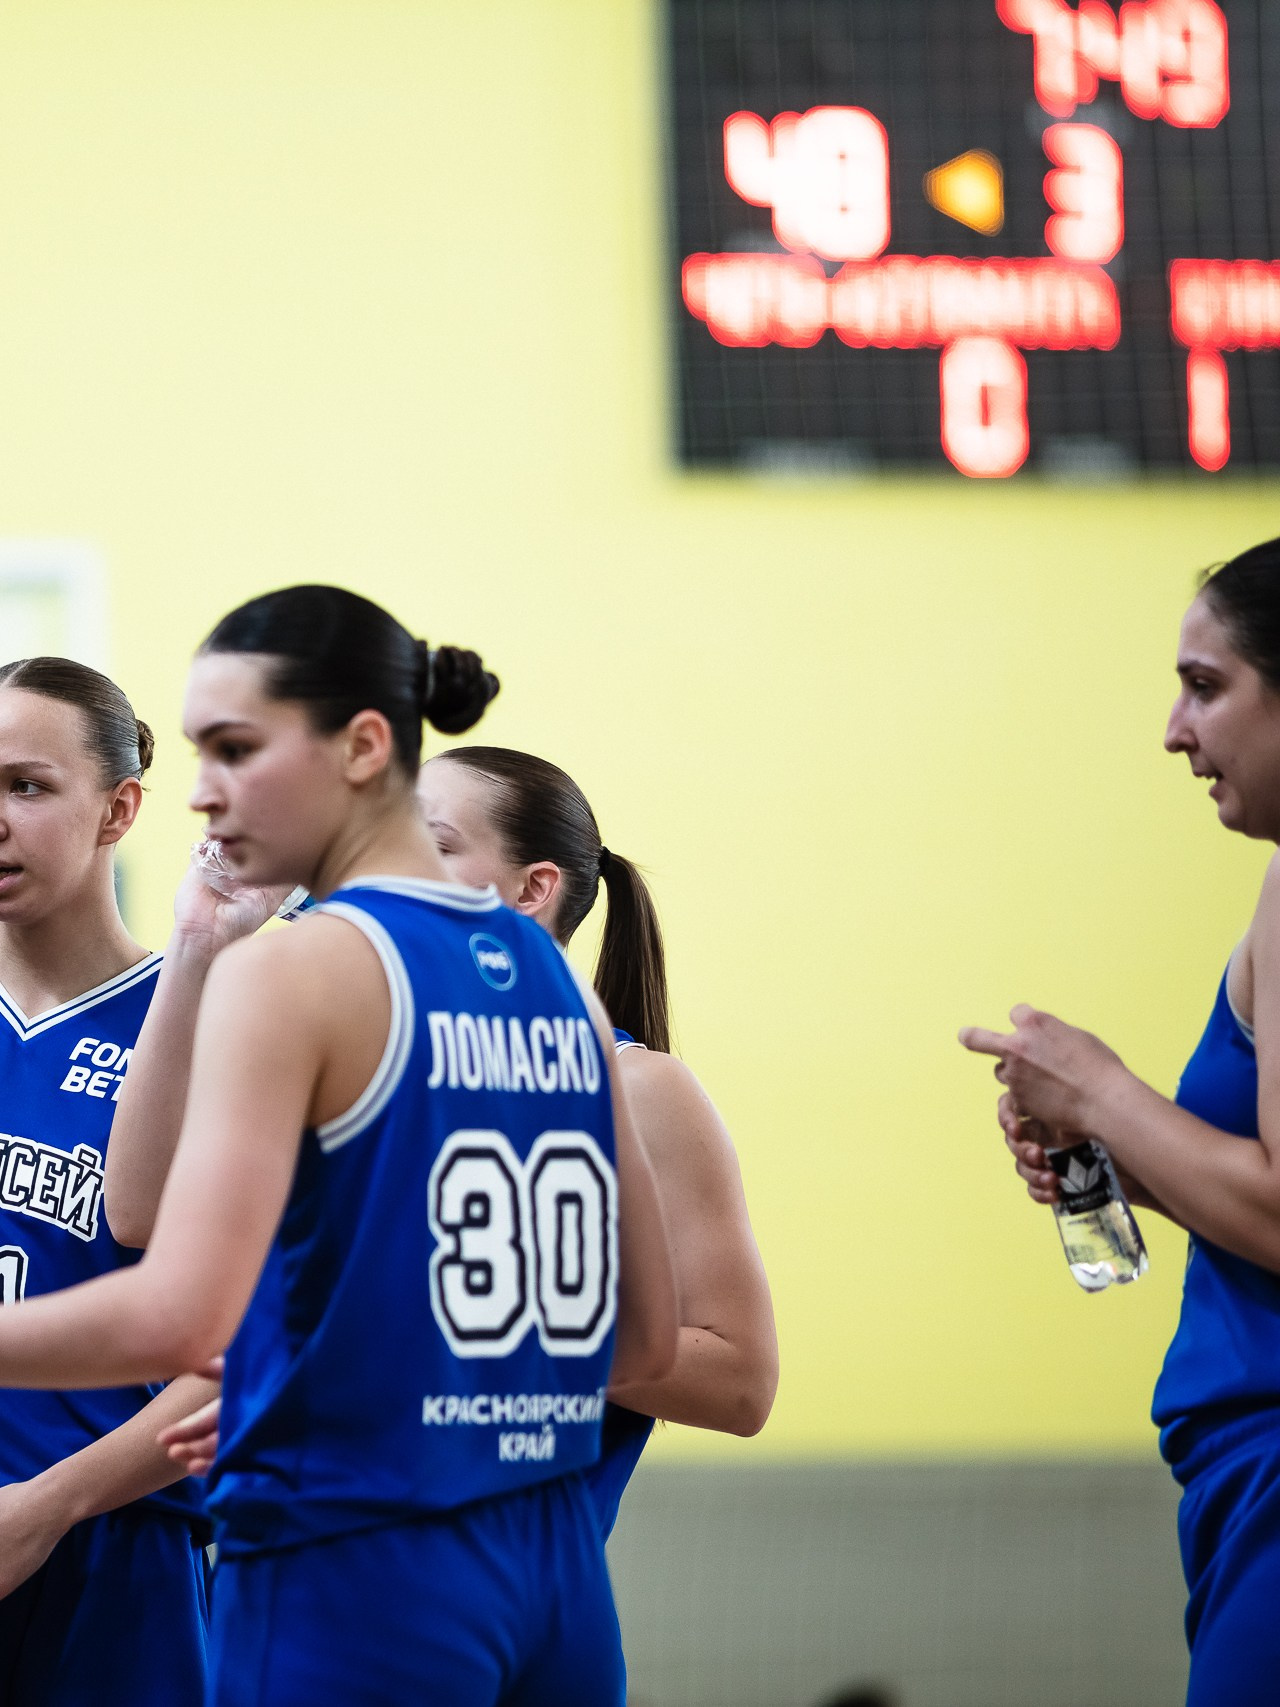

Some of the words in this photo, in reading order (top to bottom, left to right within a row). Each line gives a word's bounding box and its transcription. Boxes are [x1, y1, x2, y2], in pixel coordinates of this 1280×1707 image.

[1043, 124, 1123, 264] 3
[940, 337, 1029, 478] 0
[427, 1010, 601, 1095] ЛОМАСКО
[427, 1129, 618, 1357] 30
[422, 1387, 606, 1425] КРАСНОЯРСКИЙ
[499, 1423, 556, 1462] КРАЙ
